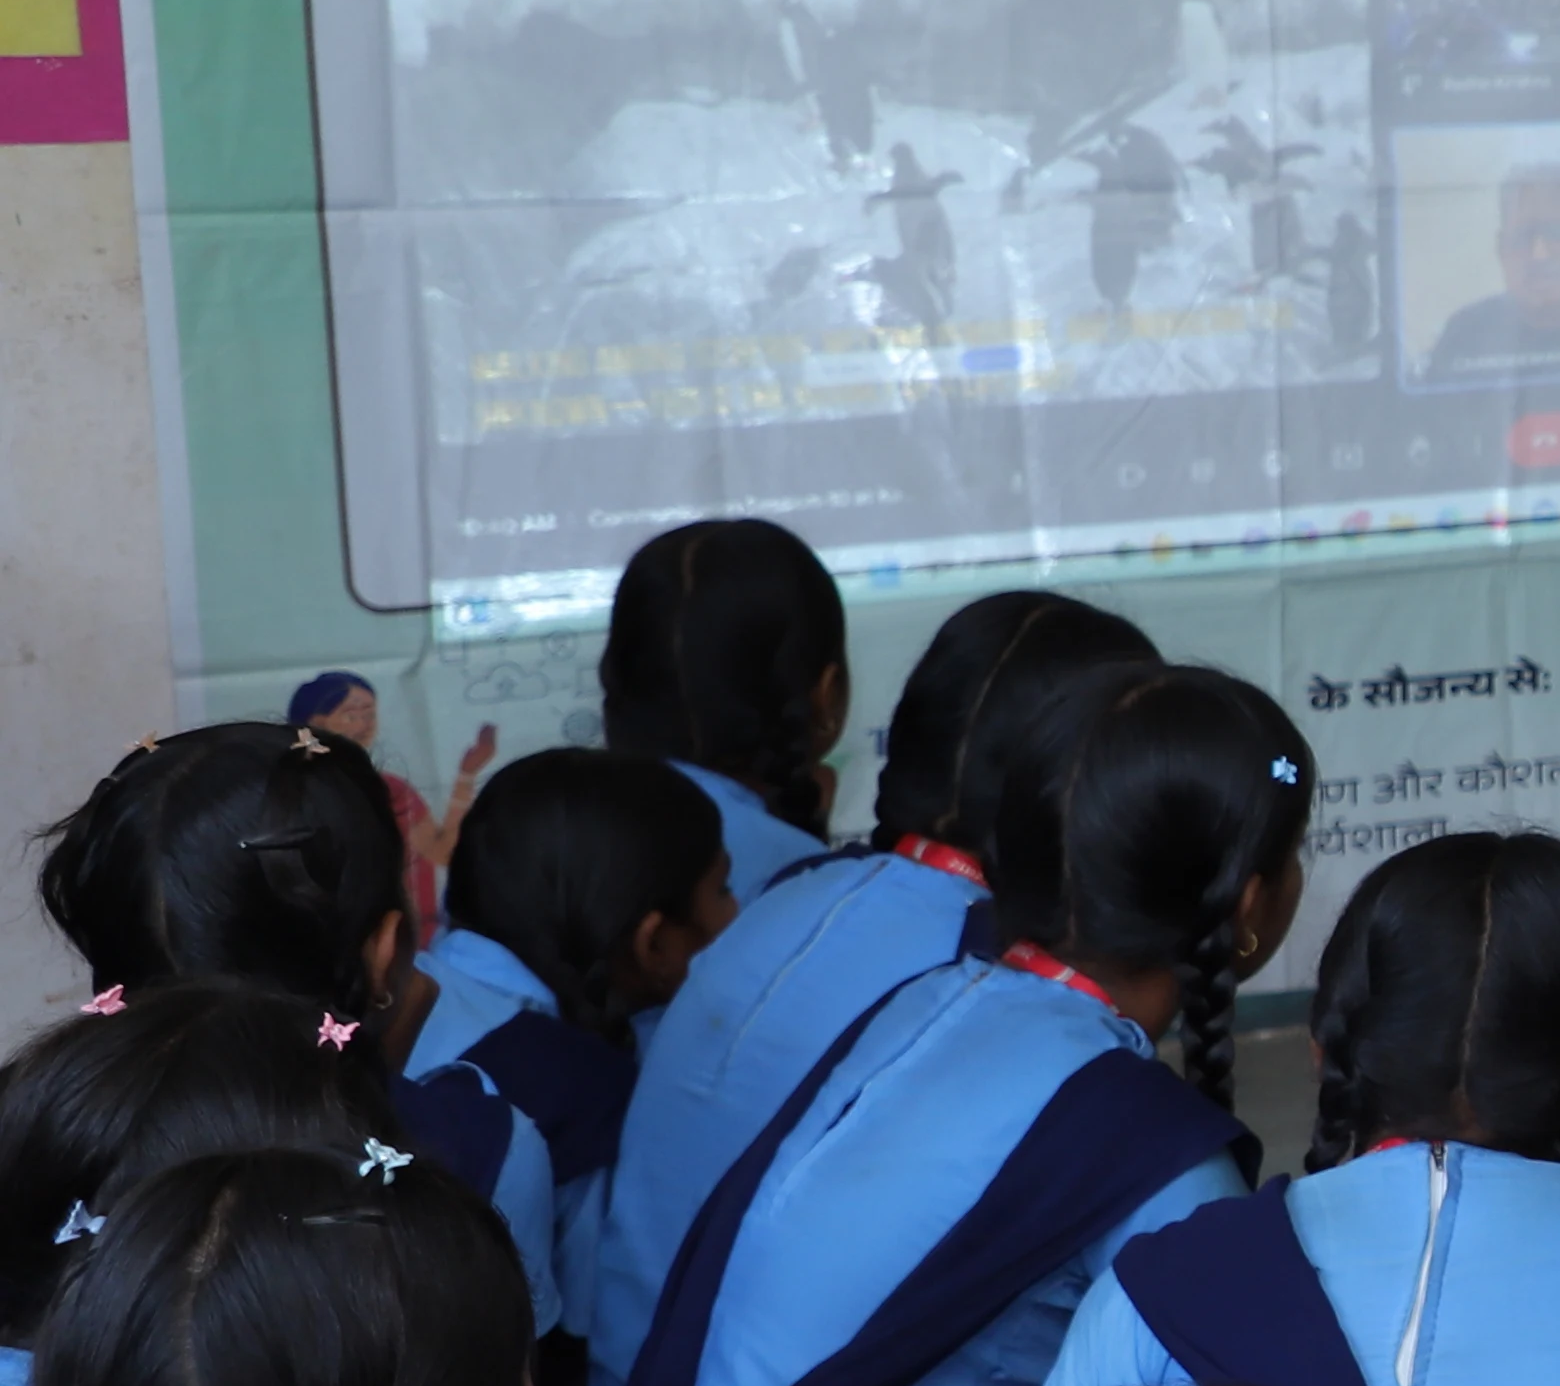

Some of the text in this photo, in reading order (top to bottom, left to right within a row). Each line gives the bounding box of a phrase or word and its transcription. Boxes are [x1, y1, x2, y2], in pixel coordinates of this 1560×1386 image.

[1308, 673, 1351, 712] के
[1362, 664, 1497, 707] सौजन्य
[1372, 759, 1443, 804] और
